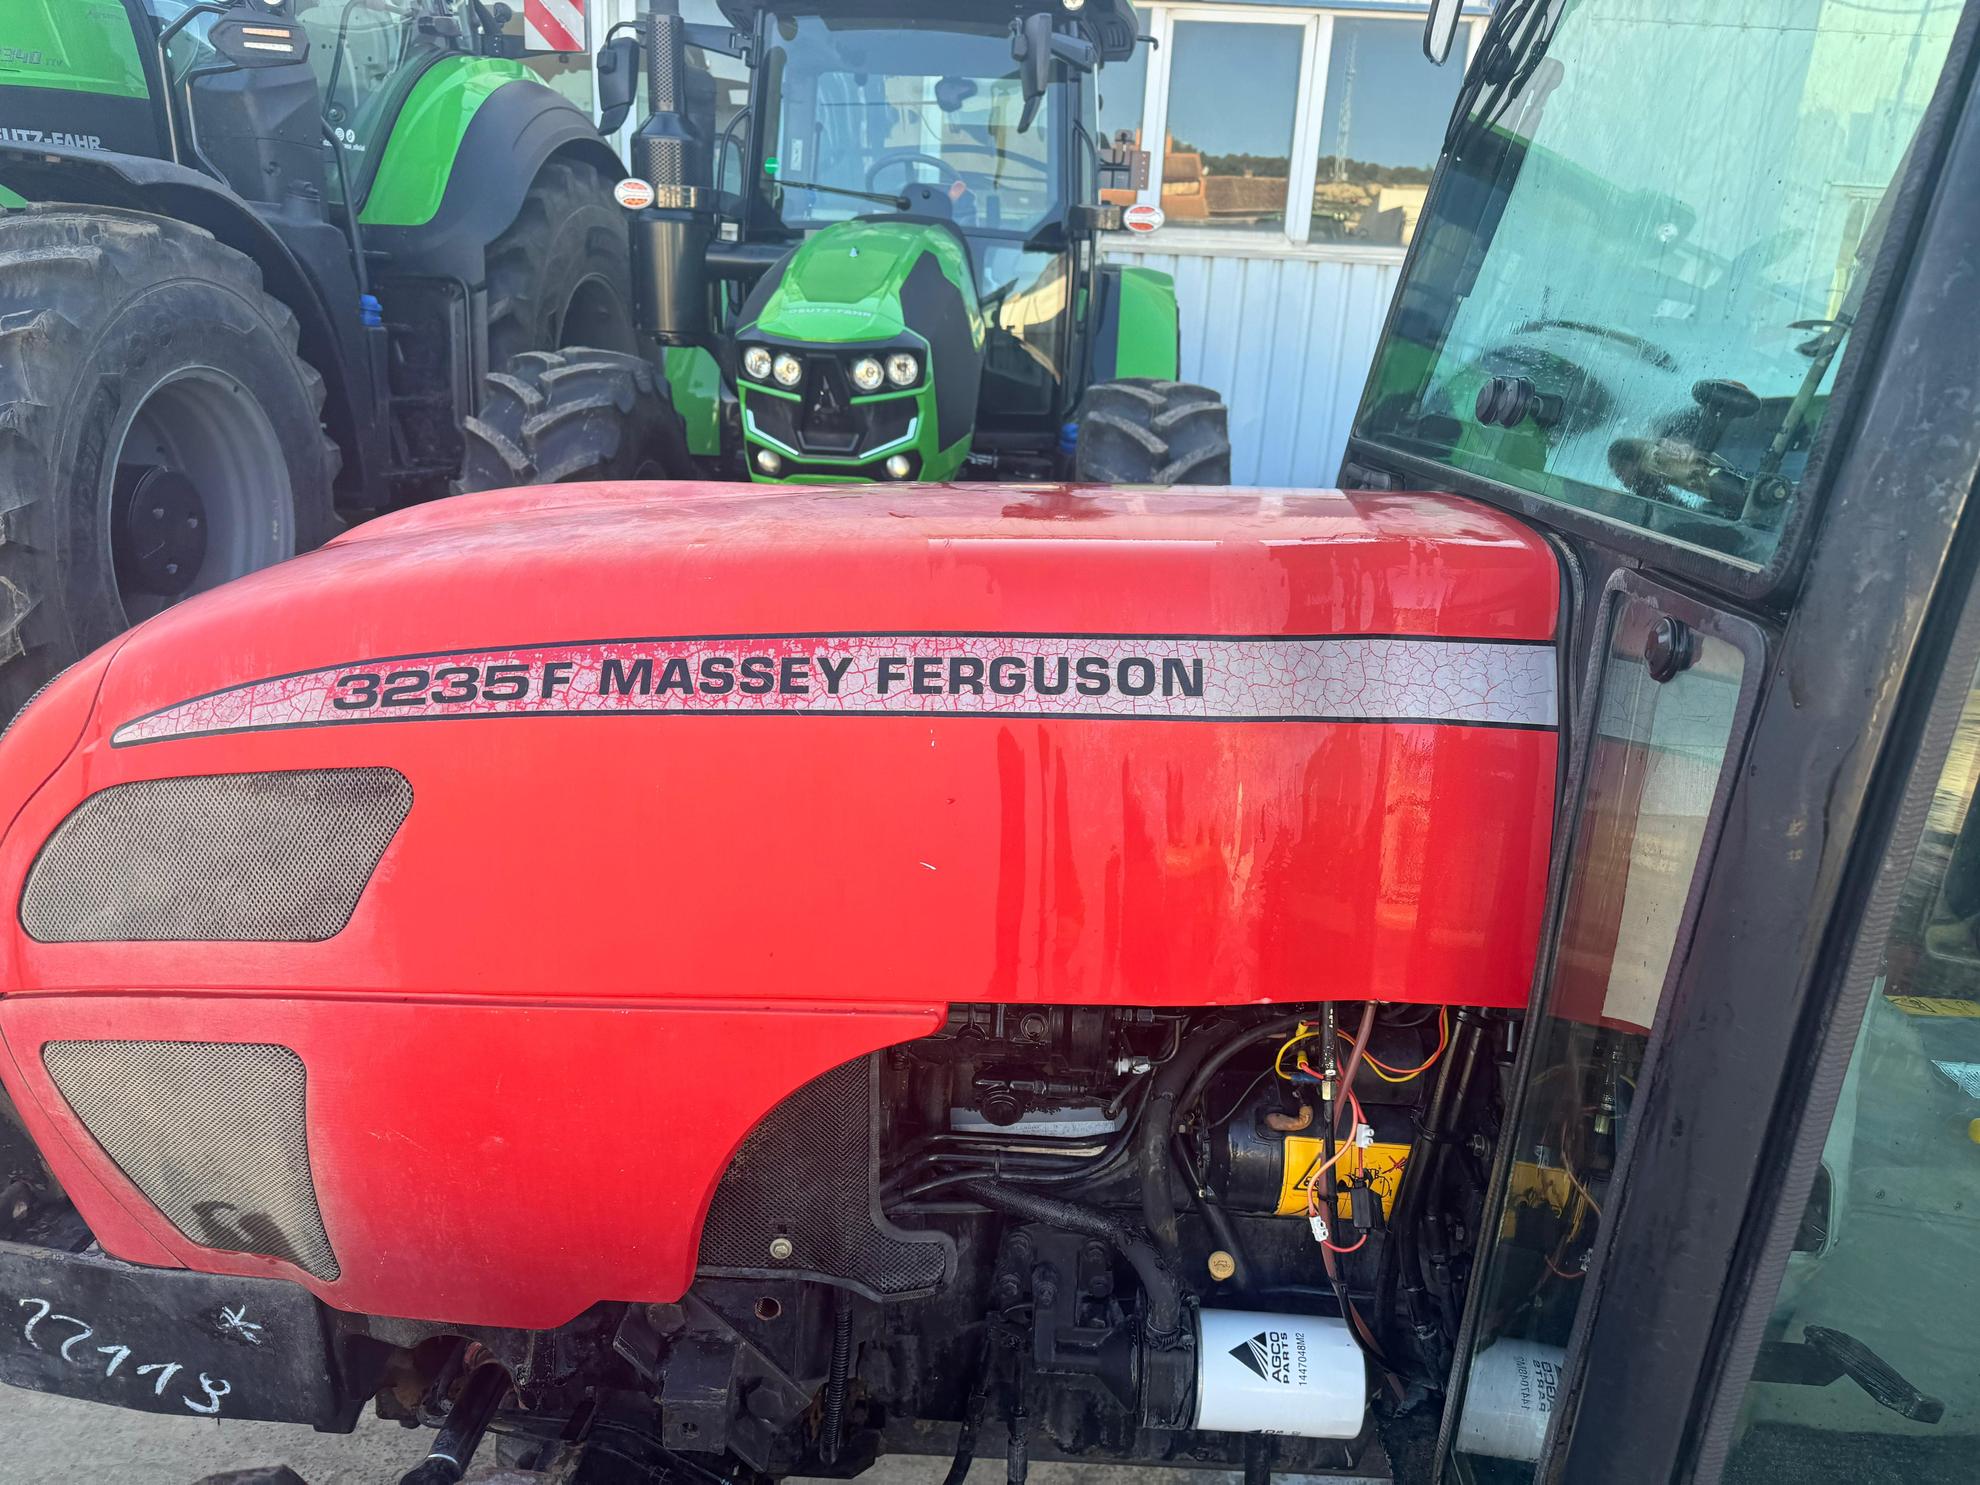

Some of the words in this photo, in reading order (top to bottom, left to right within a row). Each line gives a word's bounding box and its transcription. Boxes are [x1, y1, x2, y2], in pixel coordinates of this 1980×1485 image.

[0, 128, 102, 151] UTZ-FAHR
[599, 657, 854, 696] MASSEY
[876, 656, 1204, 697] FERGUSON
[1269, 1331, 1282, 1383] AGCO
[1280, 1332, 1290, 1384] PARTS
[1295, 1332, 1308, 1386] 1447048M2
